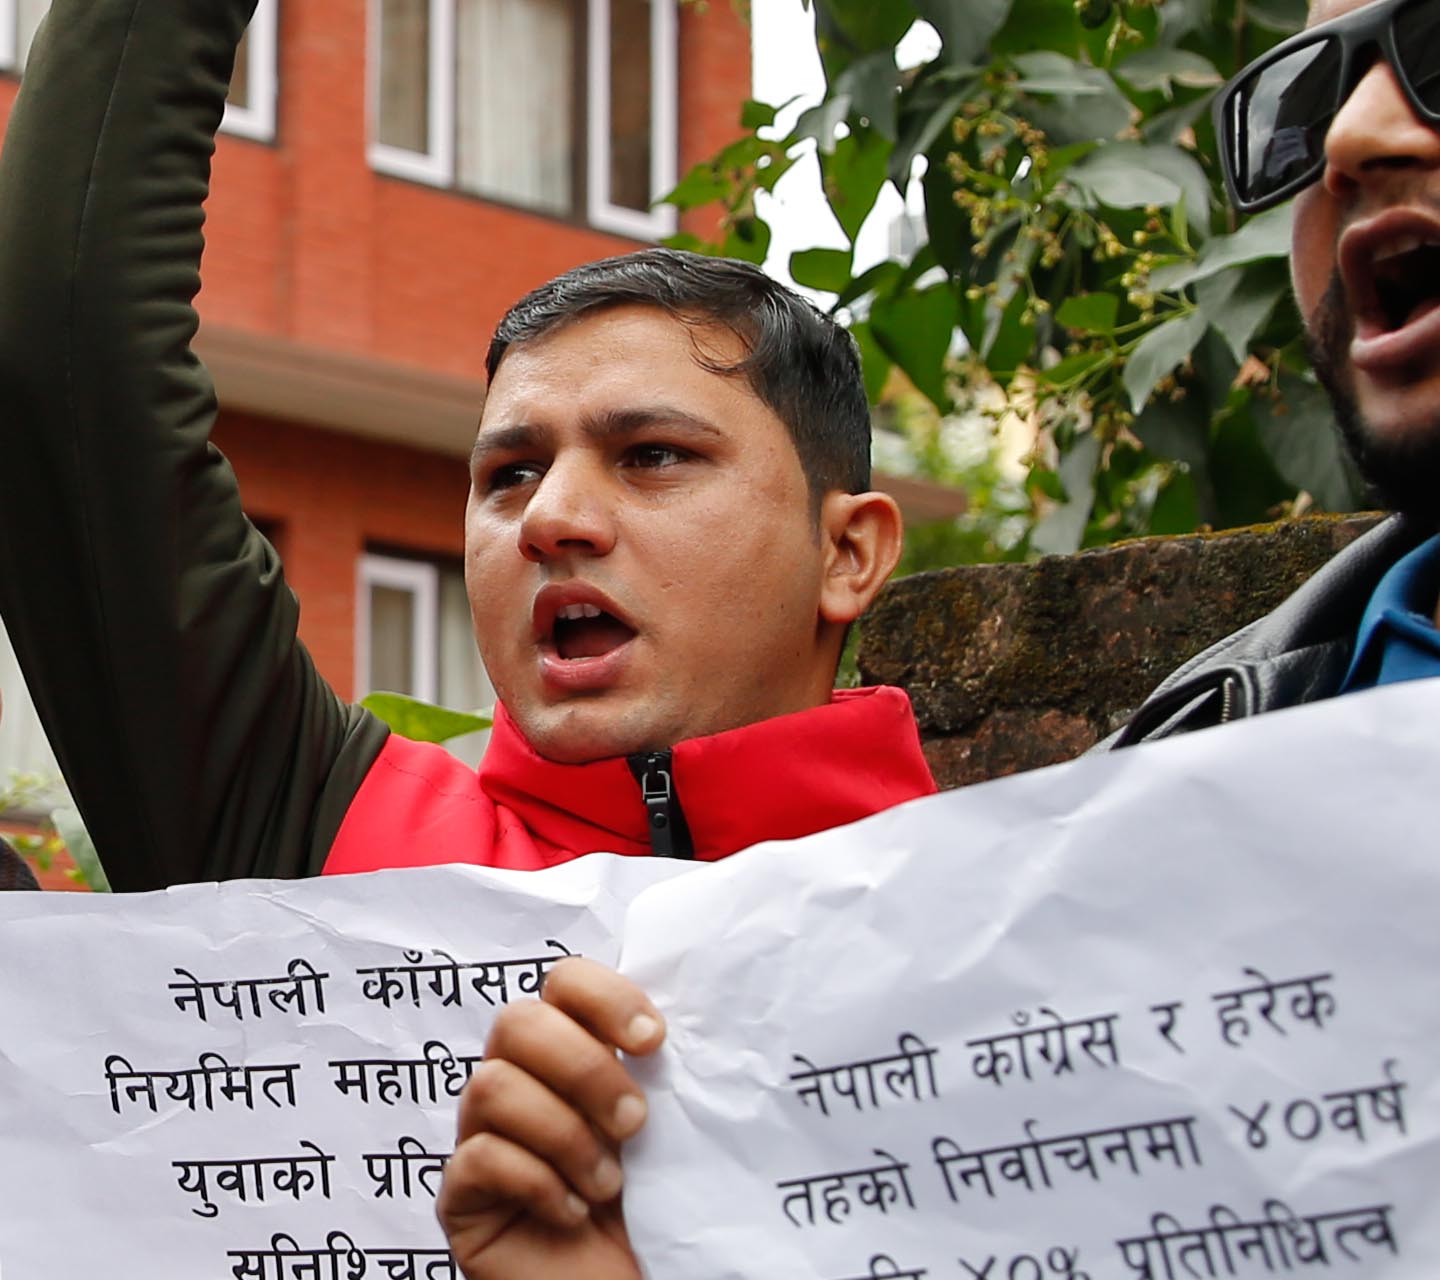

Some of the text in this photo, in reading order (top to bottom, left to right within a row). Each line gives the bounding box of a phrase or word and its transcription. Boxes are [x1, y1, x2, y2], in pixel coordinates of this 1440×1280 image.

[167, 958, 330, 1022] नेपाली
[104, 1039, 486, 1115] नियमित महाधि
[788, 967, 1336, 1117] नेपाली काँग्रेस र हरेक
[171, 1134, 452, 1218] युवाको प्रति
[776, 1148, 917, 1226] तहको
[930, 1115, 1202, 1203] निर्वाचनमा
